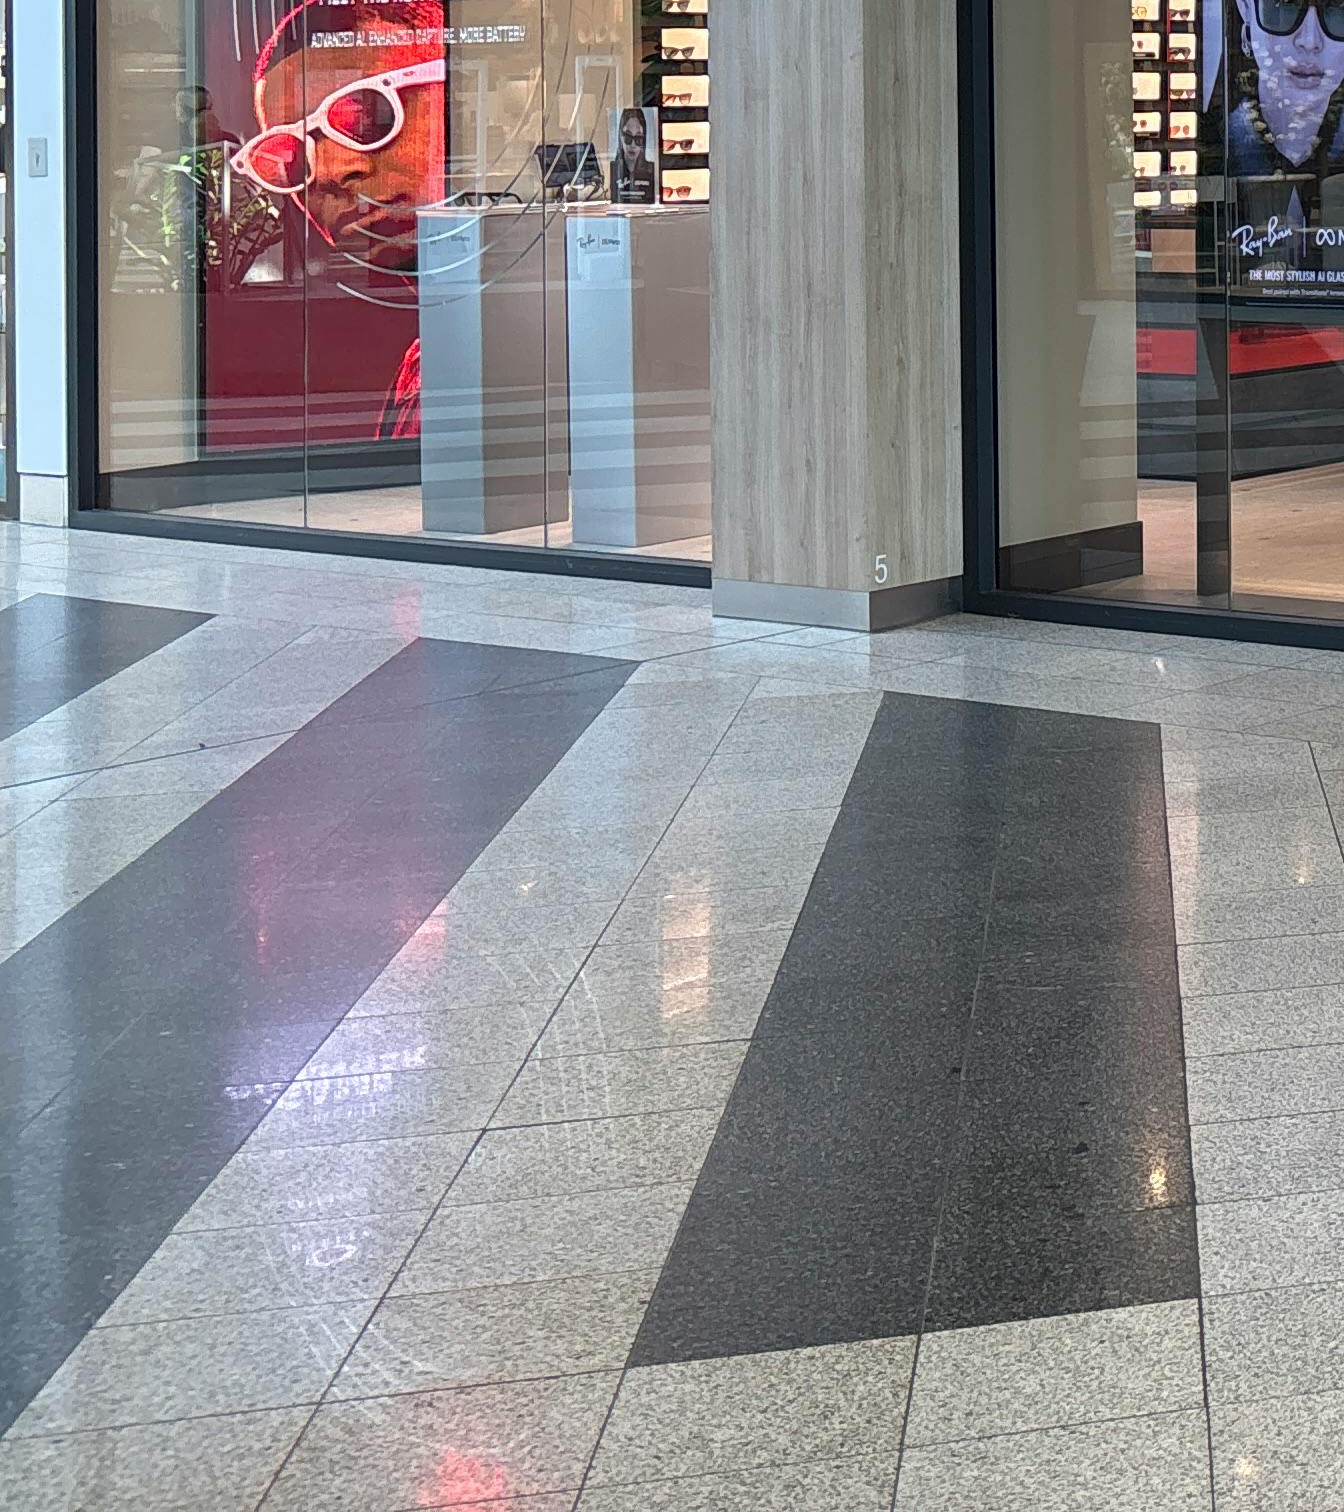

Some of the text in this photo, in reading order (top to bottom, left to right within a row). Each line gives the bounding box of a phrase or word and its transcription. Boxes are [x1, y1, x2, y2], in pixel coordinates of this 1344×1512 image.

[1249, 270, 1263, 281] THE
[1264, 270, 1285, 281] MOST
[874, 554, 888, 584] 5
